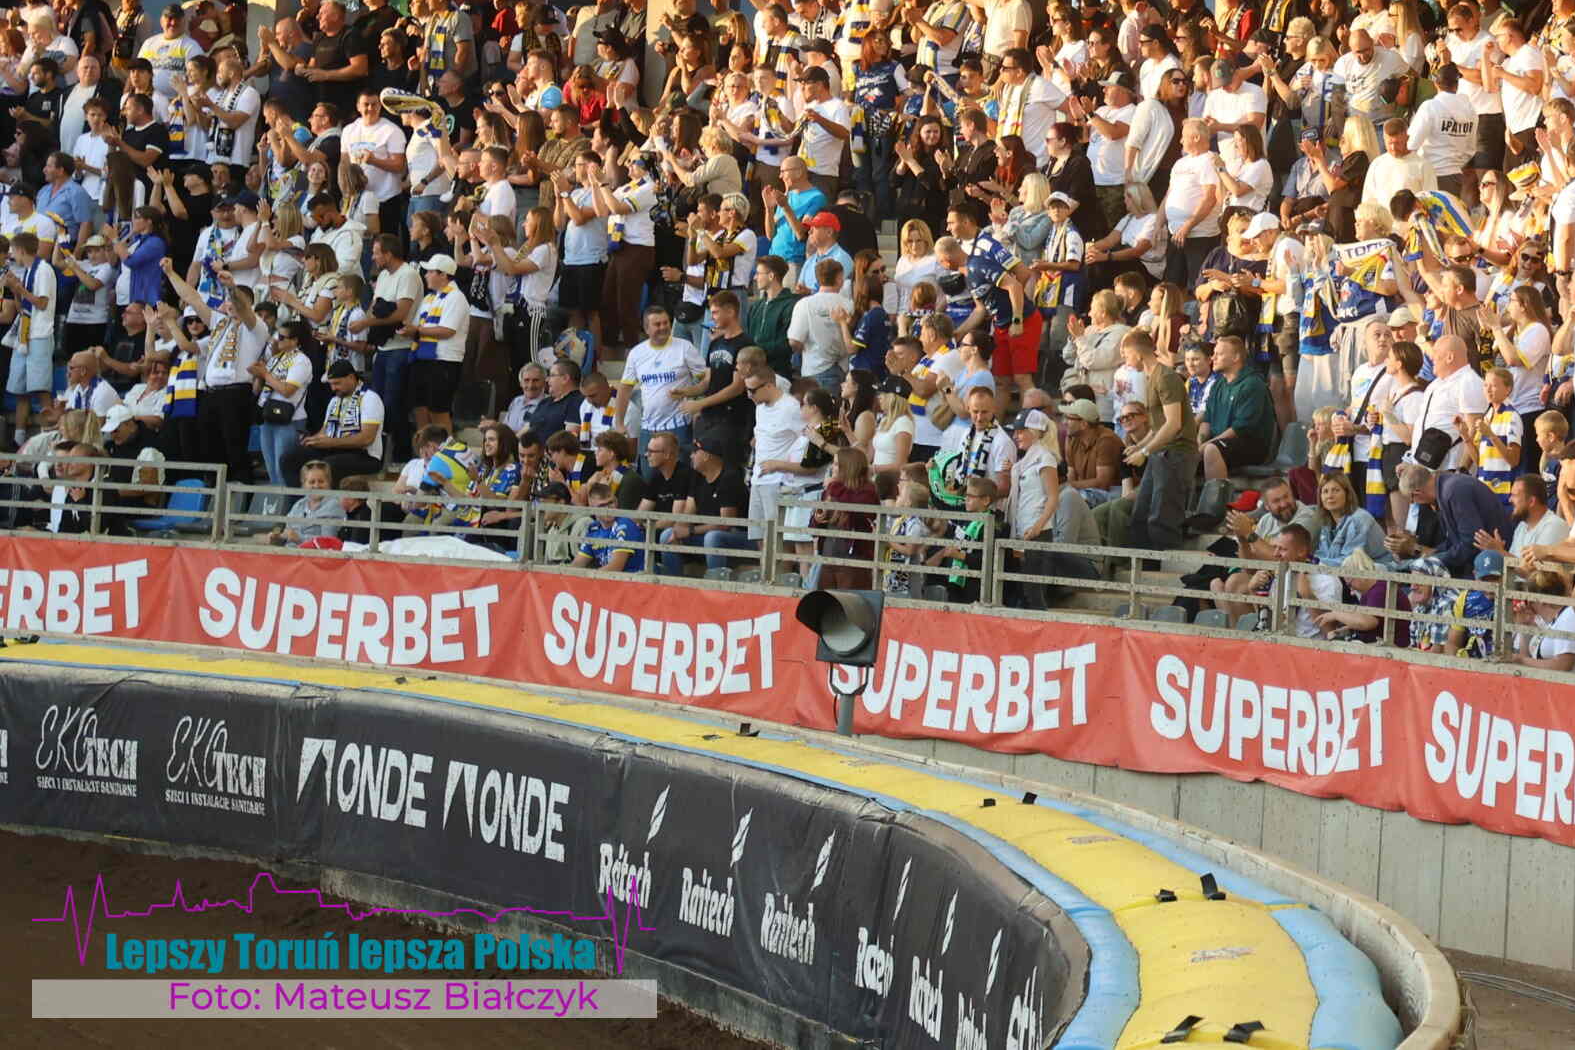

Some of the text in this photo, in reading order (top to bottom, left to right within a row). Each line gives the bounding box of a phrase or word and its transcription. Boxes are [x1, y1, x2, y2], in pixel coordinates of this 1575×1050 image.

[0, 558, 149, 634] RBET
[198, 566, 500, 666] SUPERBET
[542, 590, 782, 698] SUPERBET
[1150, 654, 1391, 776] SUPERBET
[336, 741, 434, 828] ONDE
[478, 766, 571, 862] ONDE
[678, 867, 735, 938] Raitech
